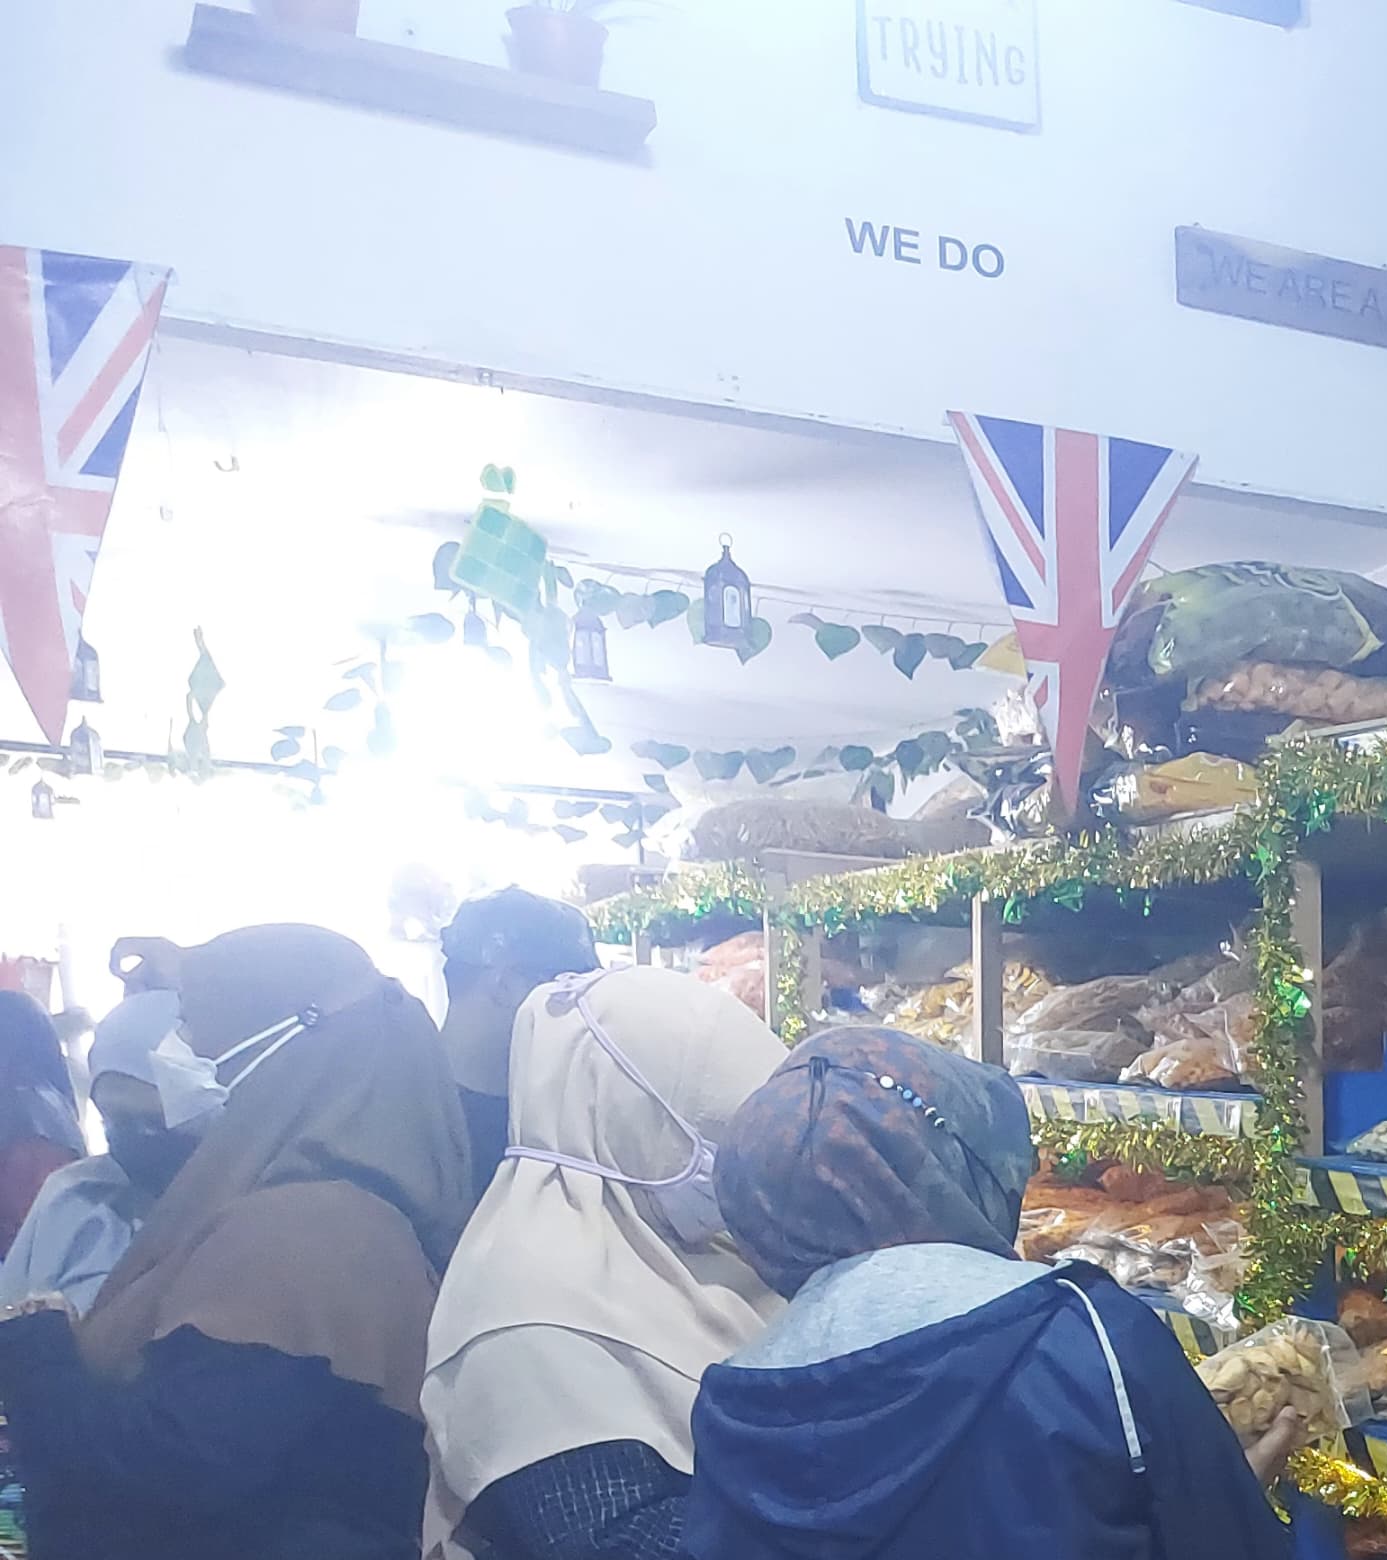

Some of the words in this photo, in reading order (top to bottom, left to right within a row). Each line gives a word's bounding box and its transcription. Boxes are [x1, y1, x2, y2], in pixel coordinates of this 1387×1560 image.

[871, 15, 1025, 87] TRYING
[844, 216, 922, 265] WE
[937, 235, 1005, 279] DO
